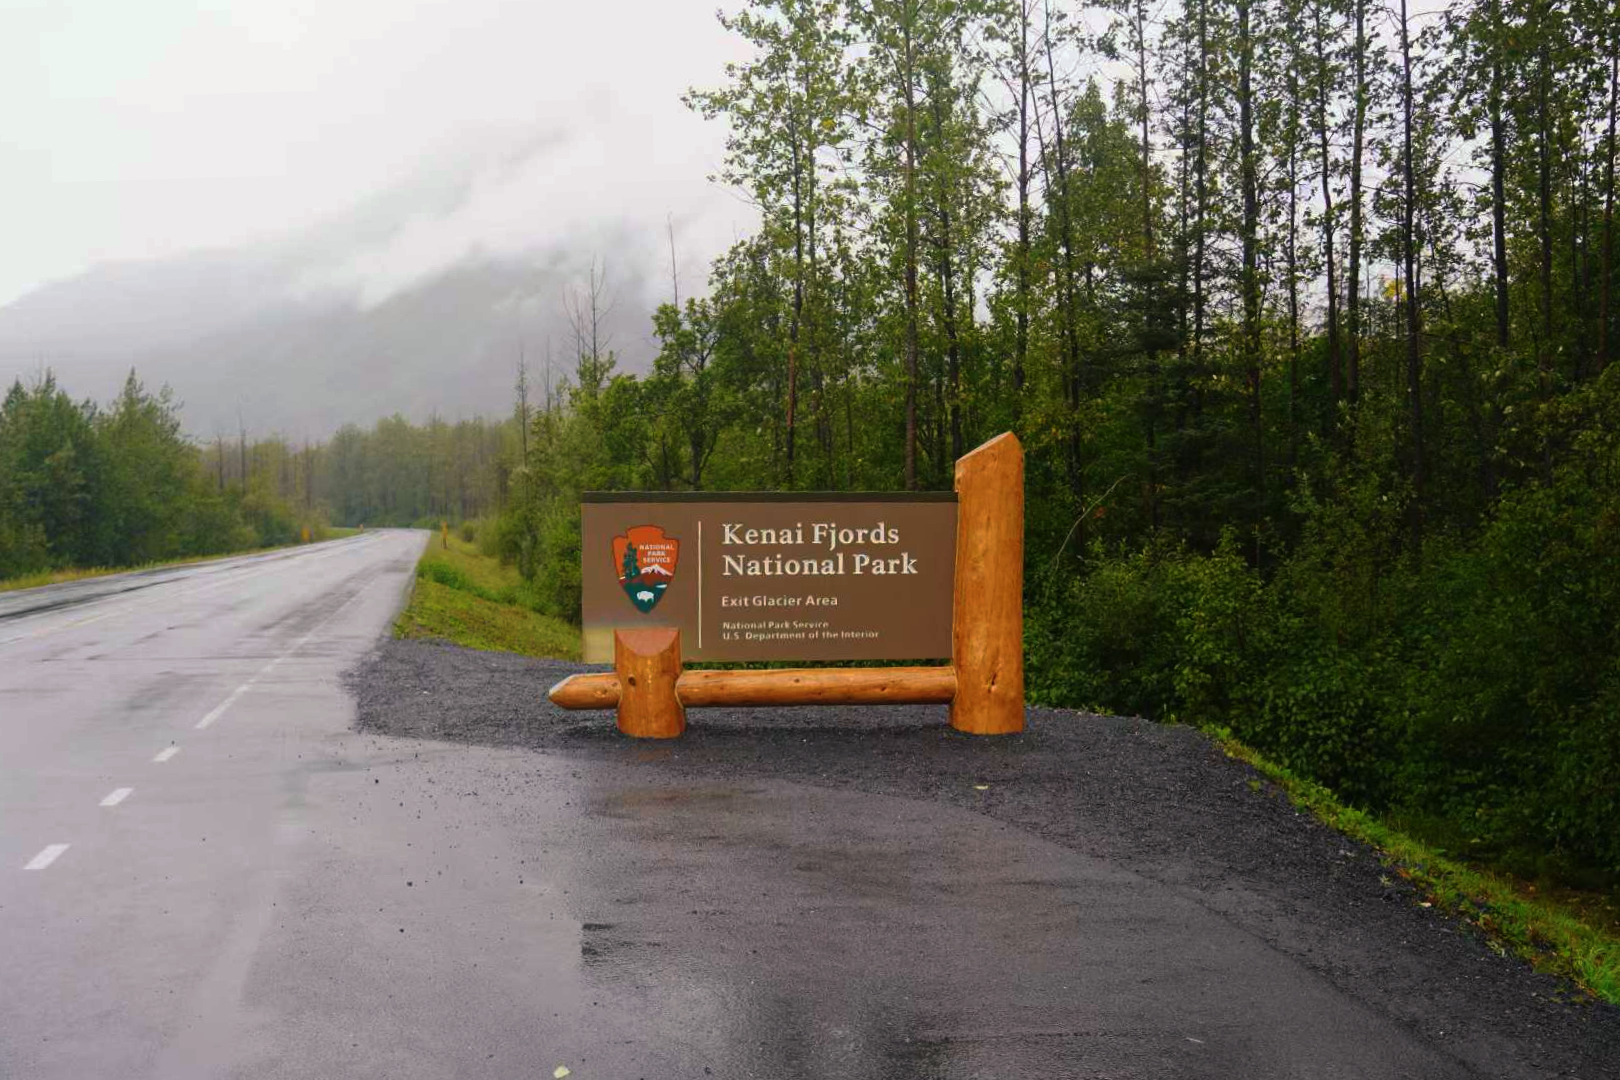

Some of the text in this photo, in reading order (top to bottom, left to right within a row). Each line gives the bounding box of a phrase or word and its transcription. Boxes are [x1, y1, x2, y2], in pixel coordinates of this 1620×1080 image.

[721, 522, 900, 551] Kenai Fjords
[722, 552, 918, 576] National Park
[721, 595, 838, 607] Exit Glacier Area
[722, 620, 828, 629] National Park Service
[745, 631, 805, 641] Department
[808, 630, 819, 639] of
[822, 630, 838, 639] the
[841, 630, 879, 639] Interior
